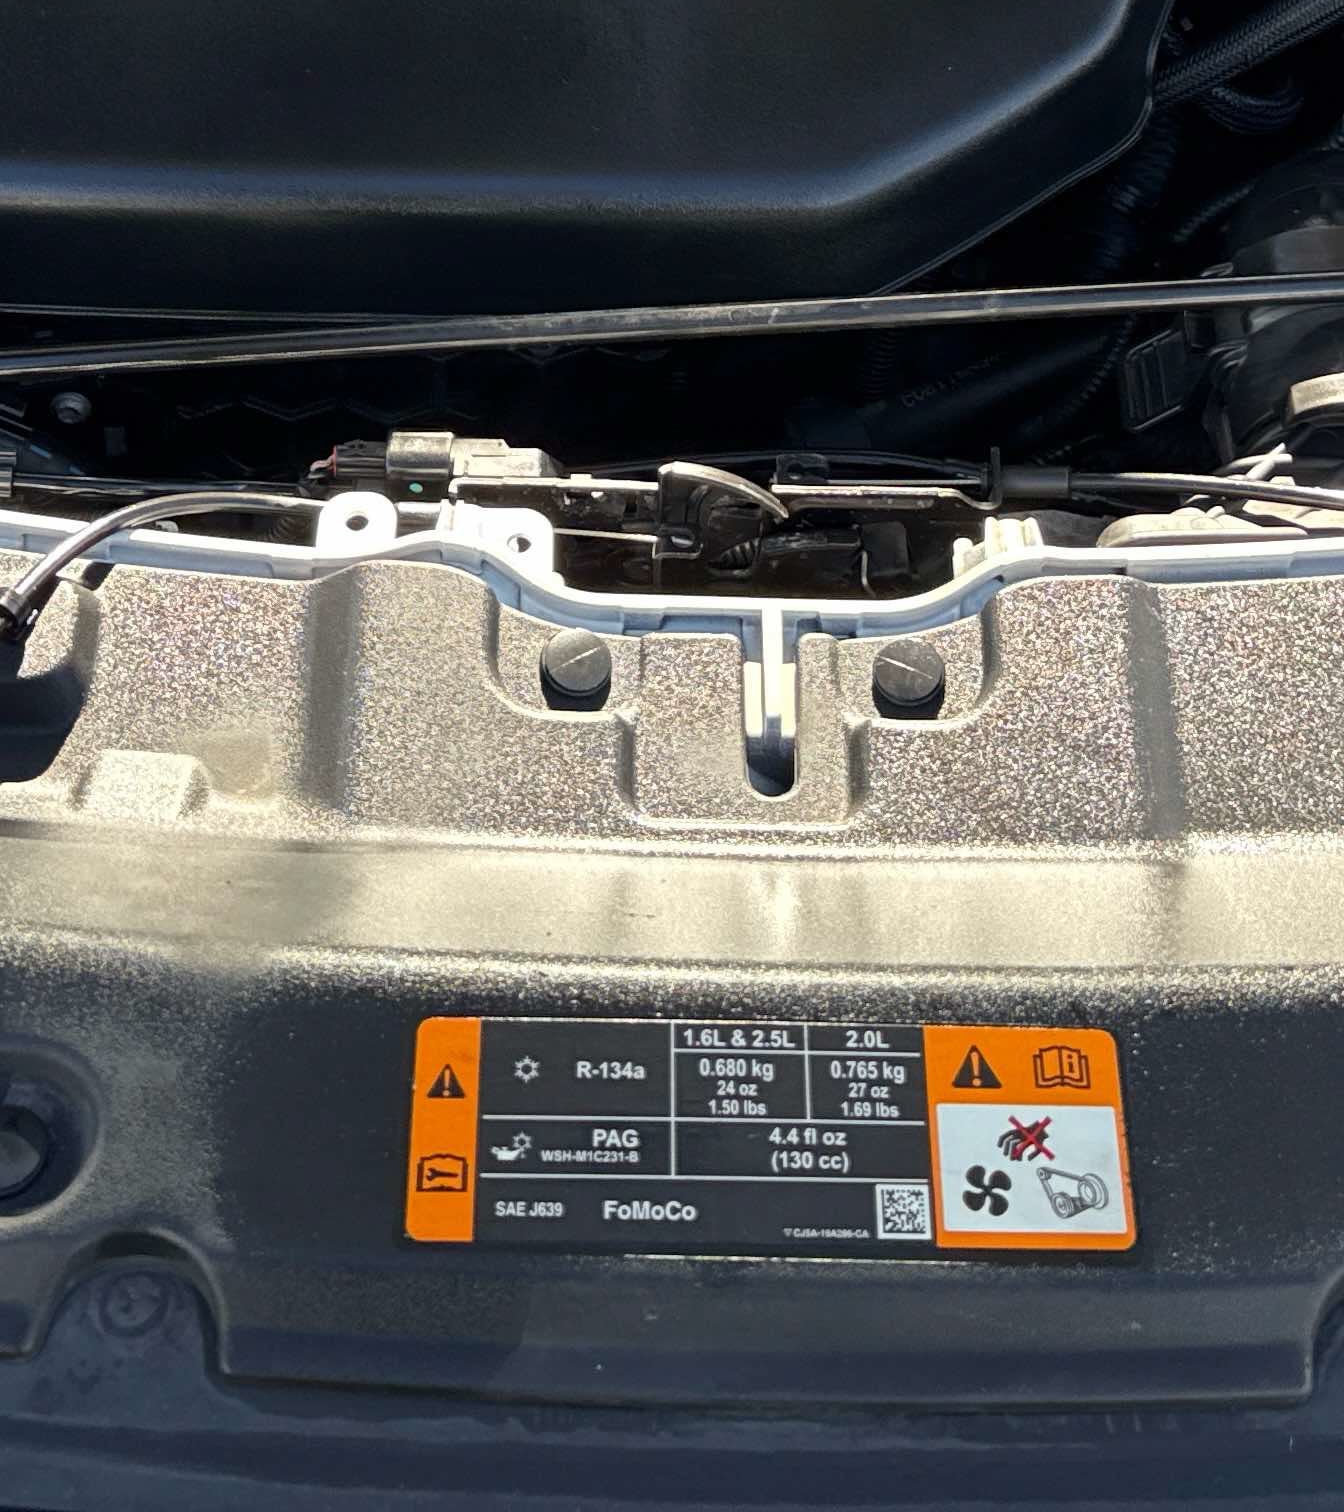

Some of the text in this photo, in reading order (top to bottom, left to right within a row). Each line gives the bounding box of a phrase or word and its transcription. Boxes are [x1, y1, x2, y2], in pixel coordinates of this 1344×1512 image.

[683, 1028, 796, 1049] 1.6L & 2.5L
[845, 1029, 890, 1050] 2.0L
[575, 1060, 647, 1080] R-134a
[699, 1057, 775, 1083] 0.680 kg
[830, 1059, 906, 1084] 0.765 kg
[716, 1080, 758, 1097] 24 oz
[848, 1082, 890, 1099] 27 oz
[708, 1099, 767, 1116] 1.50 lbs
[840, 1101, 900, 1119] 1.69 lbs
[592, 1129, 640, 1148] PAG
[768, 1126, 848, 1146] 4.4 fl oz
[540, 1150, 640, 1163] WSH-M1C231-B
[771, 1151, 850, 1173] (130 cc)
[495, 1201, 564, 1217] SAE J639
[602, 1200, 697, 1221] FoMoCo
